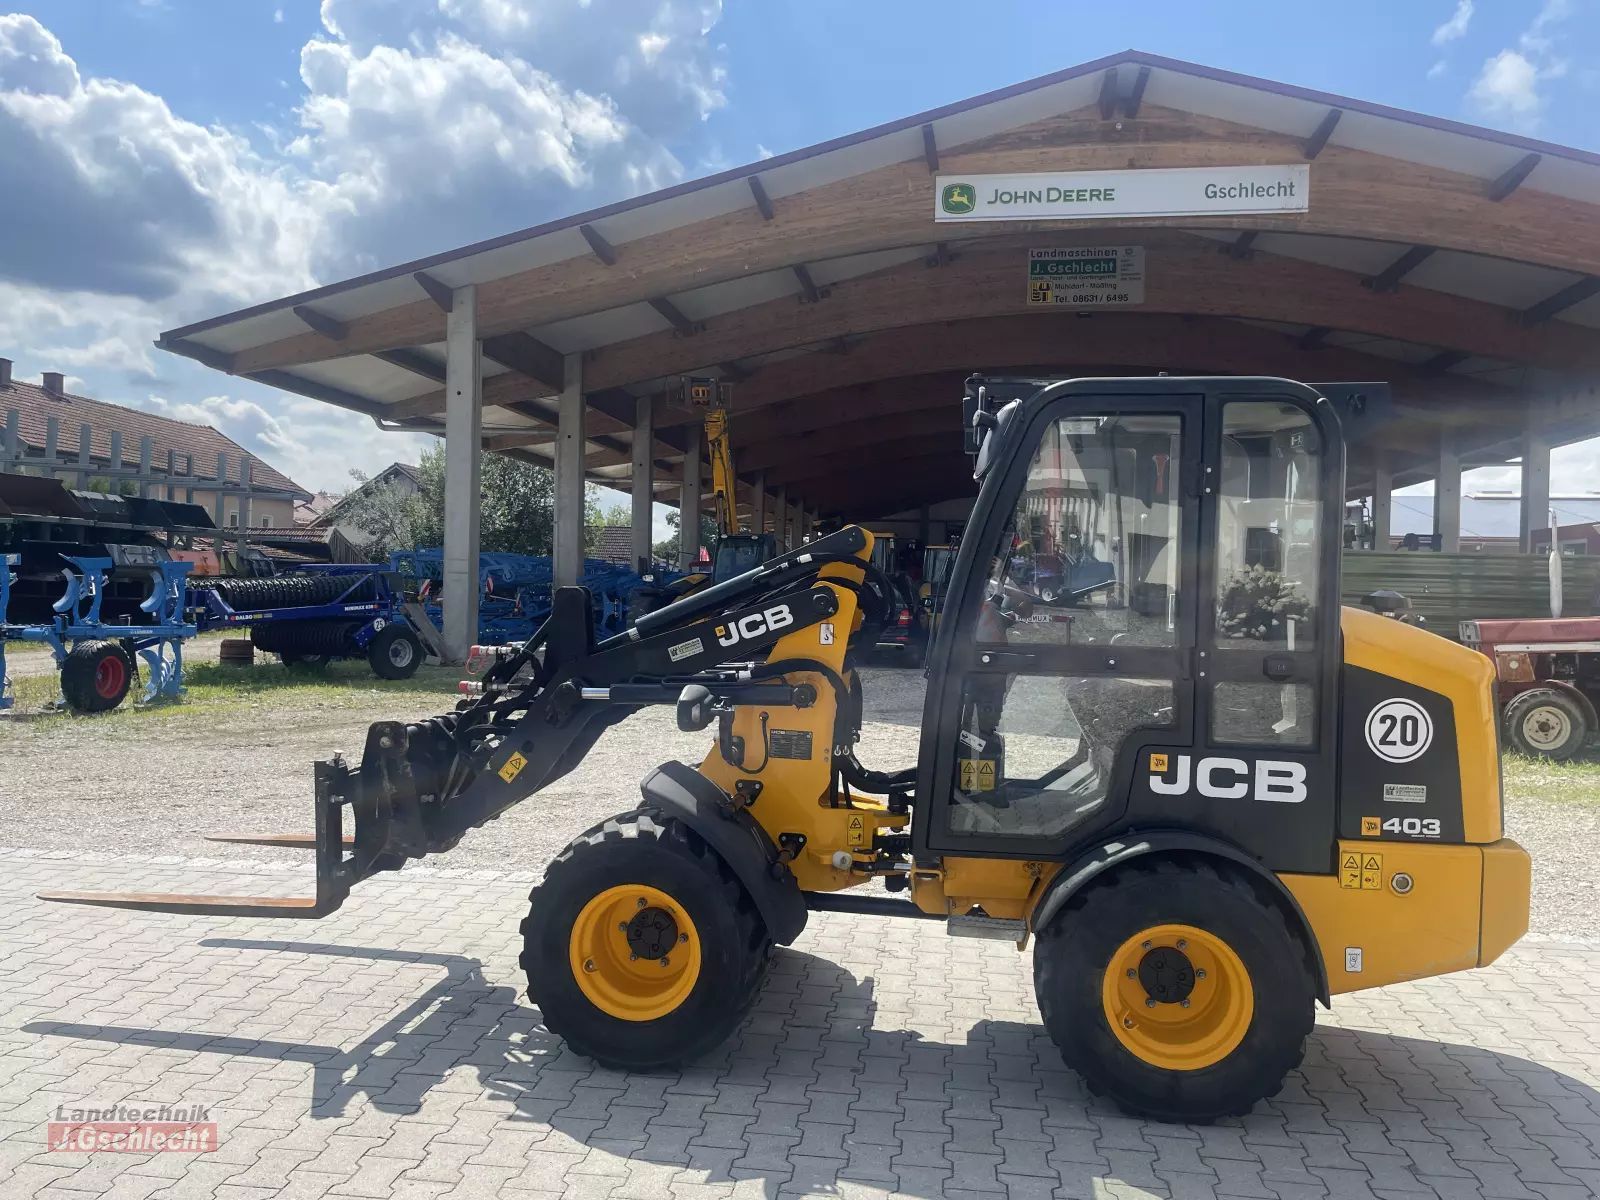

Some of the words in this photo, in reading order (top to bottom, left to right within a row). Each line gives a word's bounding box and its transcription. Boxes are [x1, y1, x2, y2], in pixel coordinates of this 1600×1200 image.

[986, 188, 1043, 205] JOHN
[1046, 187, 1116, 203] DEERE
[1204, 181, 1296, 200] Gschlecht
[1030, 248, 1118, 258] Landmaschinen
[1033, 263, 1044, 273] J.
[1047, 260, 1115, 273] Gschlecht
[1054, 295, 1070, 303] Tel.
[375, 619, 384, 630] 25
[718, 604, 794, 647] JCB
[1379, 714, 1419, 746] 20
[1150, 755, 1307, 802] JCB
[1382, 817, 1441, 835] 403
